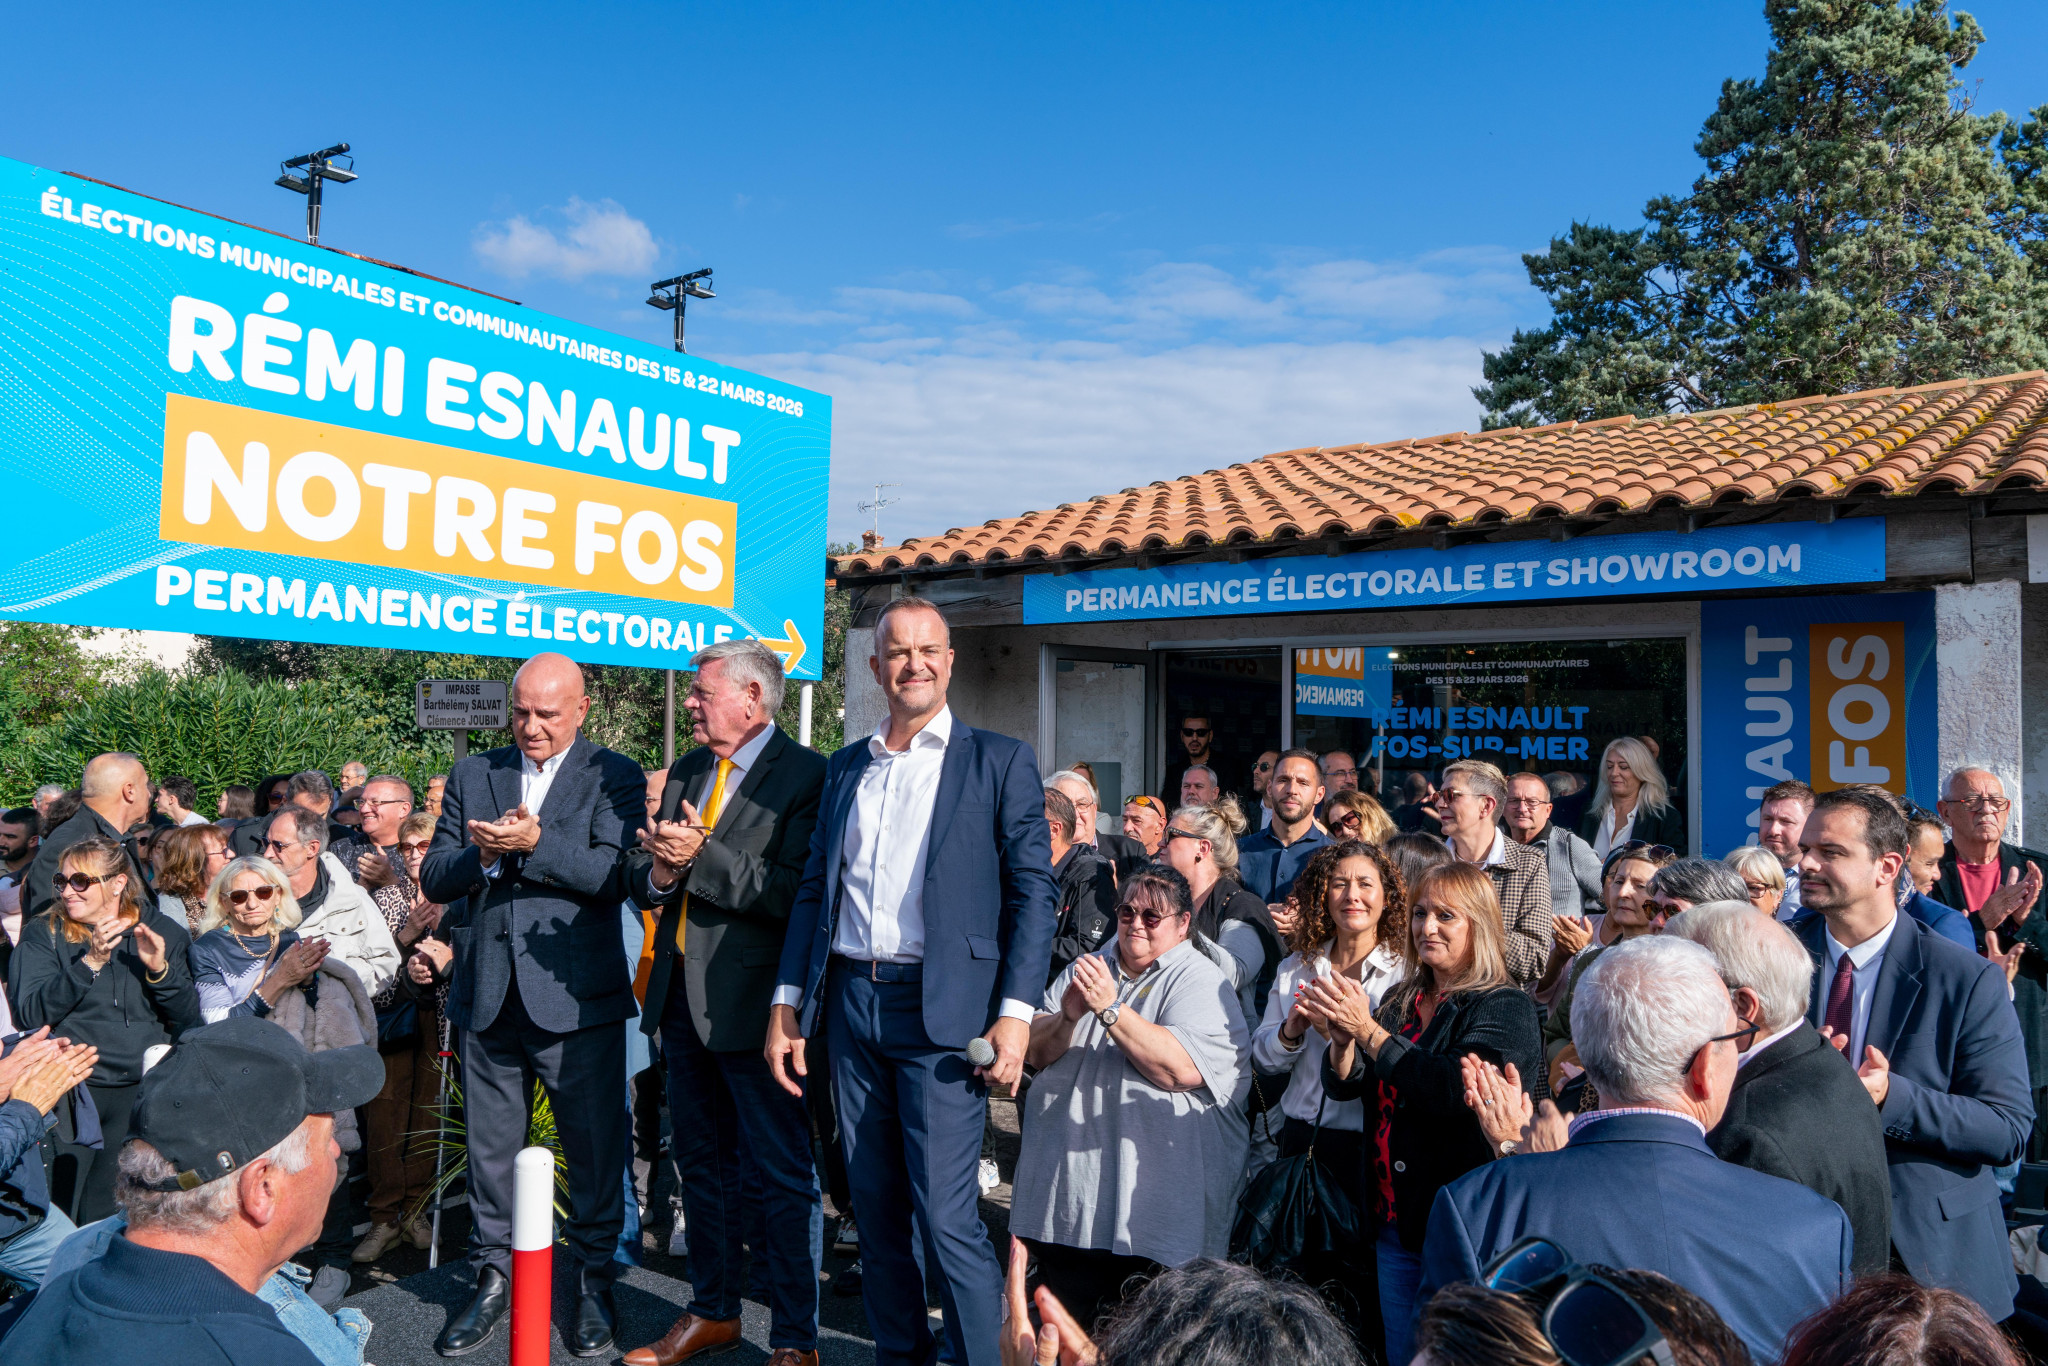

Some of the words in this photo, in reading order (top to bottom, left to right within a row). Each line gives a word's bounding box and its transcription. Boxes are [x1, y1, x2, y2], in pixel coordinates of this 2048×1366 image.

[41, 186, 216, 259] ÉLECTIONS
[220, 241, 396, 308] MUNICIPALES
[399, 291, 431, 316] ET
[433, 301, 623, 369] COMMUNAUTAIRES
[625, 354, 661, 379] DES
[662, 365, 681, 385] 15
[683, 371, 696, 389] &
[698, 375, 719, 395] 22
[721, 380, 765, 407] MARS
[767, 393, 804, 418] 2026
[168, 292, 405, 417] RÉMI
[426, 358, 741, 485] ESNAULT
[182, 431, 557, 570] NOTRE
[574, 500, 724, 592] FOS
[1065, 578, 1261, 612] PERMANENCE
[1267, 564, 1486, 602] ÉLECTORALE
[1493, 560, 1541, 589] ET
[1546, 543, 1801, 587] SHOWROOM
[155, 565, 498, 635] PERMANENCE
[506, 590, 734, 652] ÉLECTORALE
[1421, 661, 1483, 670] MUNICIPALES
[1484, 661, 1496, 670] ET
[1498, 659, 1590, 669] COMMUNAUTAIRES
[1425, 676, 1444, 684] DES
[1445, 676, 1454, 684] 15
[1455, 676, 1463, 684] &
[1463, 676, 1475, 684] 22
[1476, 675, 1504, 684] MARS
[1504, 675, 1529, 683] 2026
[445, 684, 481, 695] IMPASSE
[423, 699, 469, 713] Barthélémy
[471, 699, 502, 711] SALVAT
[426, 714, 466, 726] Clémence
[468, 714, 499, 726] JOUBIN
[1371, 700, 1441, 730] RÉMI
[1448, 706, 1590, 730] ESNAULT
[1827, 634, 1891, 784] FOS
[1371, 735, 1590, 761] FOS-SUR-MER
